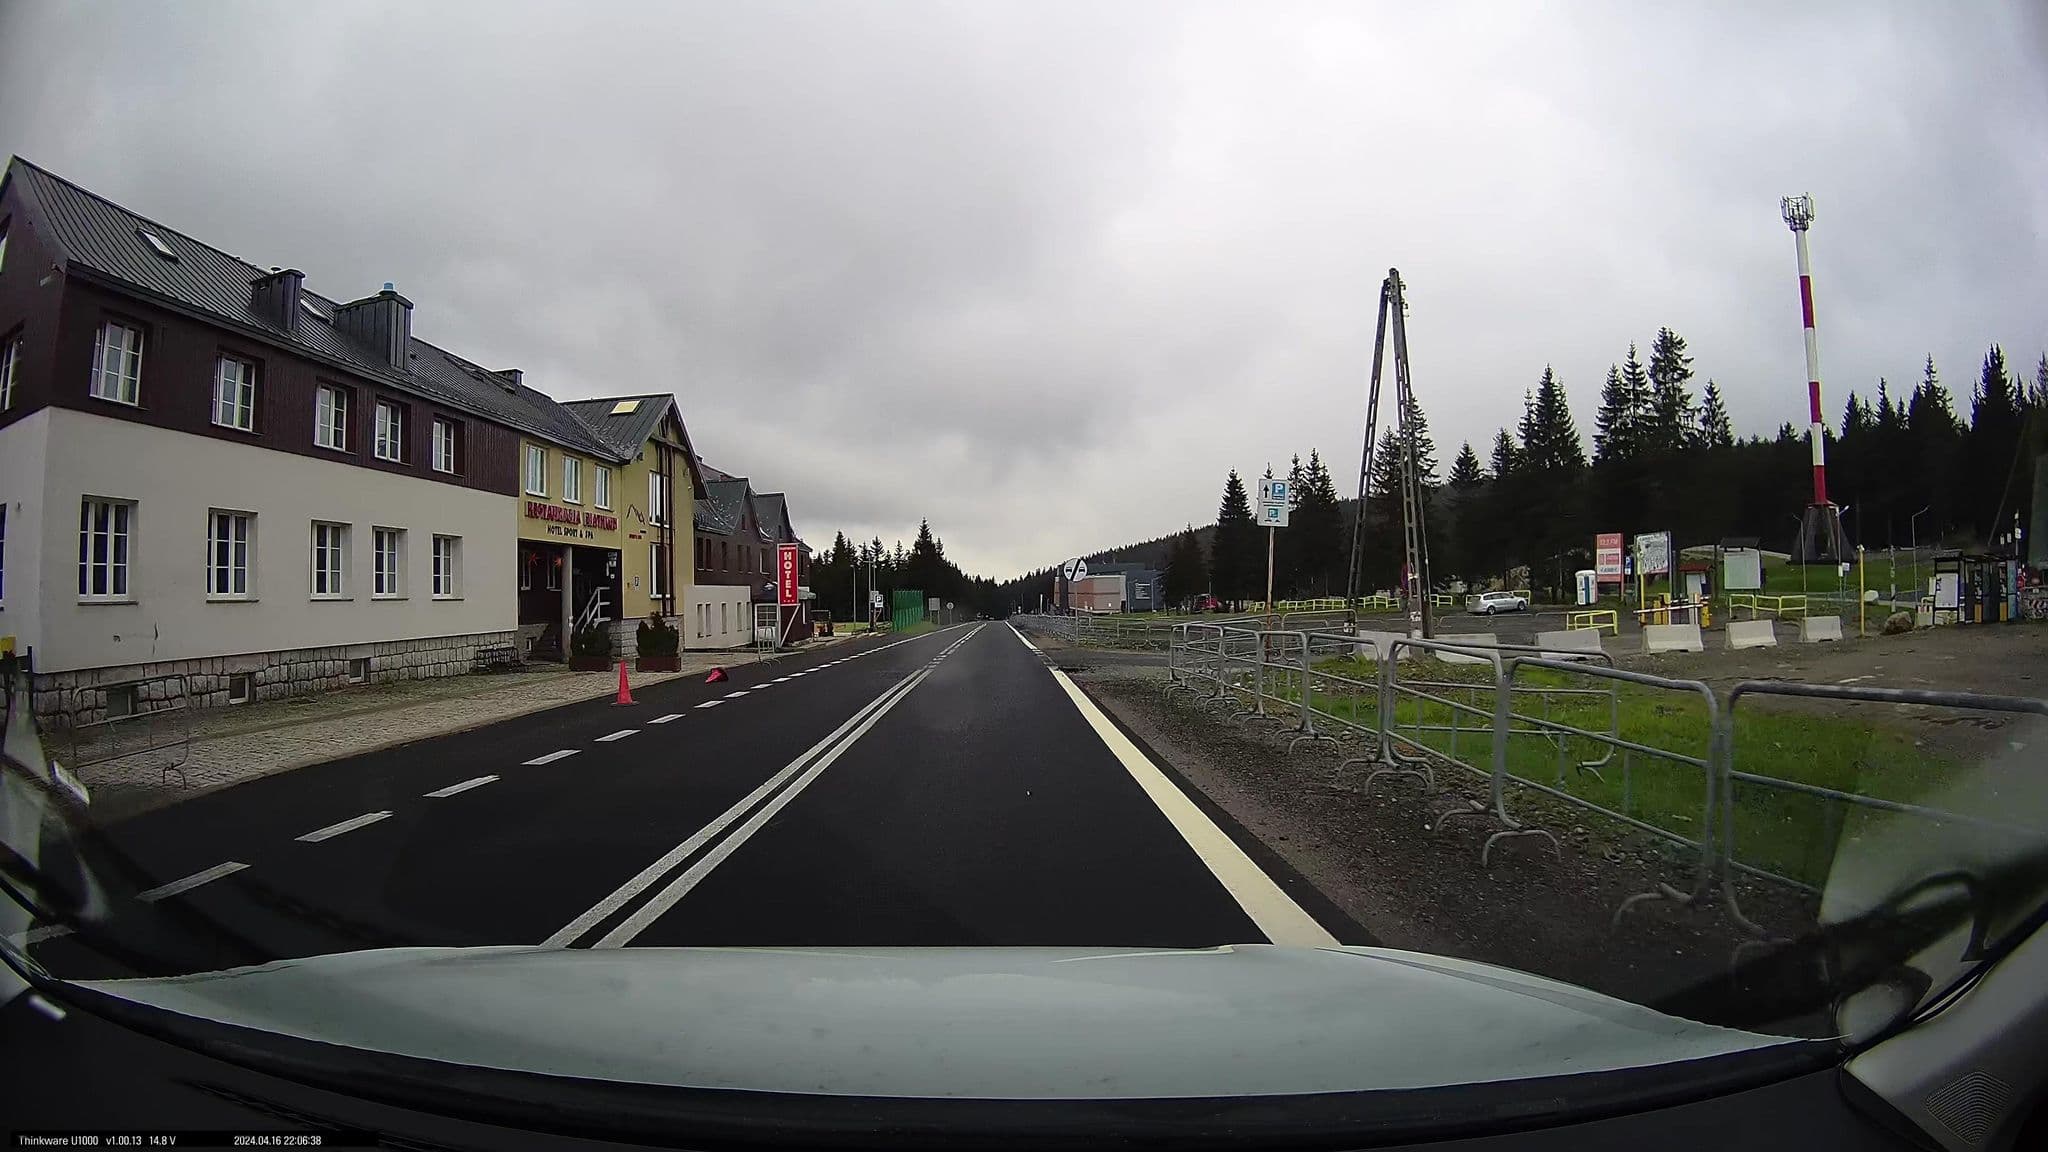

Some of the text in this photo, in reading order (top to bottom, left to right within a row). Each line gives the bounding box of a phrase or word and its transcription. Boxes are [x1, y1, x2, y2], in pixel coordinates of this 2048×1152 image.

[547, 525, 562, 536] HOTEL
[563, 527, 578, 537] SPORT
[585, 530, 594, 540] SPA
[783, 551, 793, 598] HOTEL
